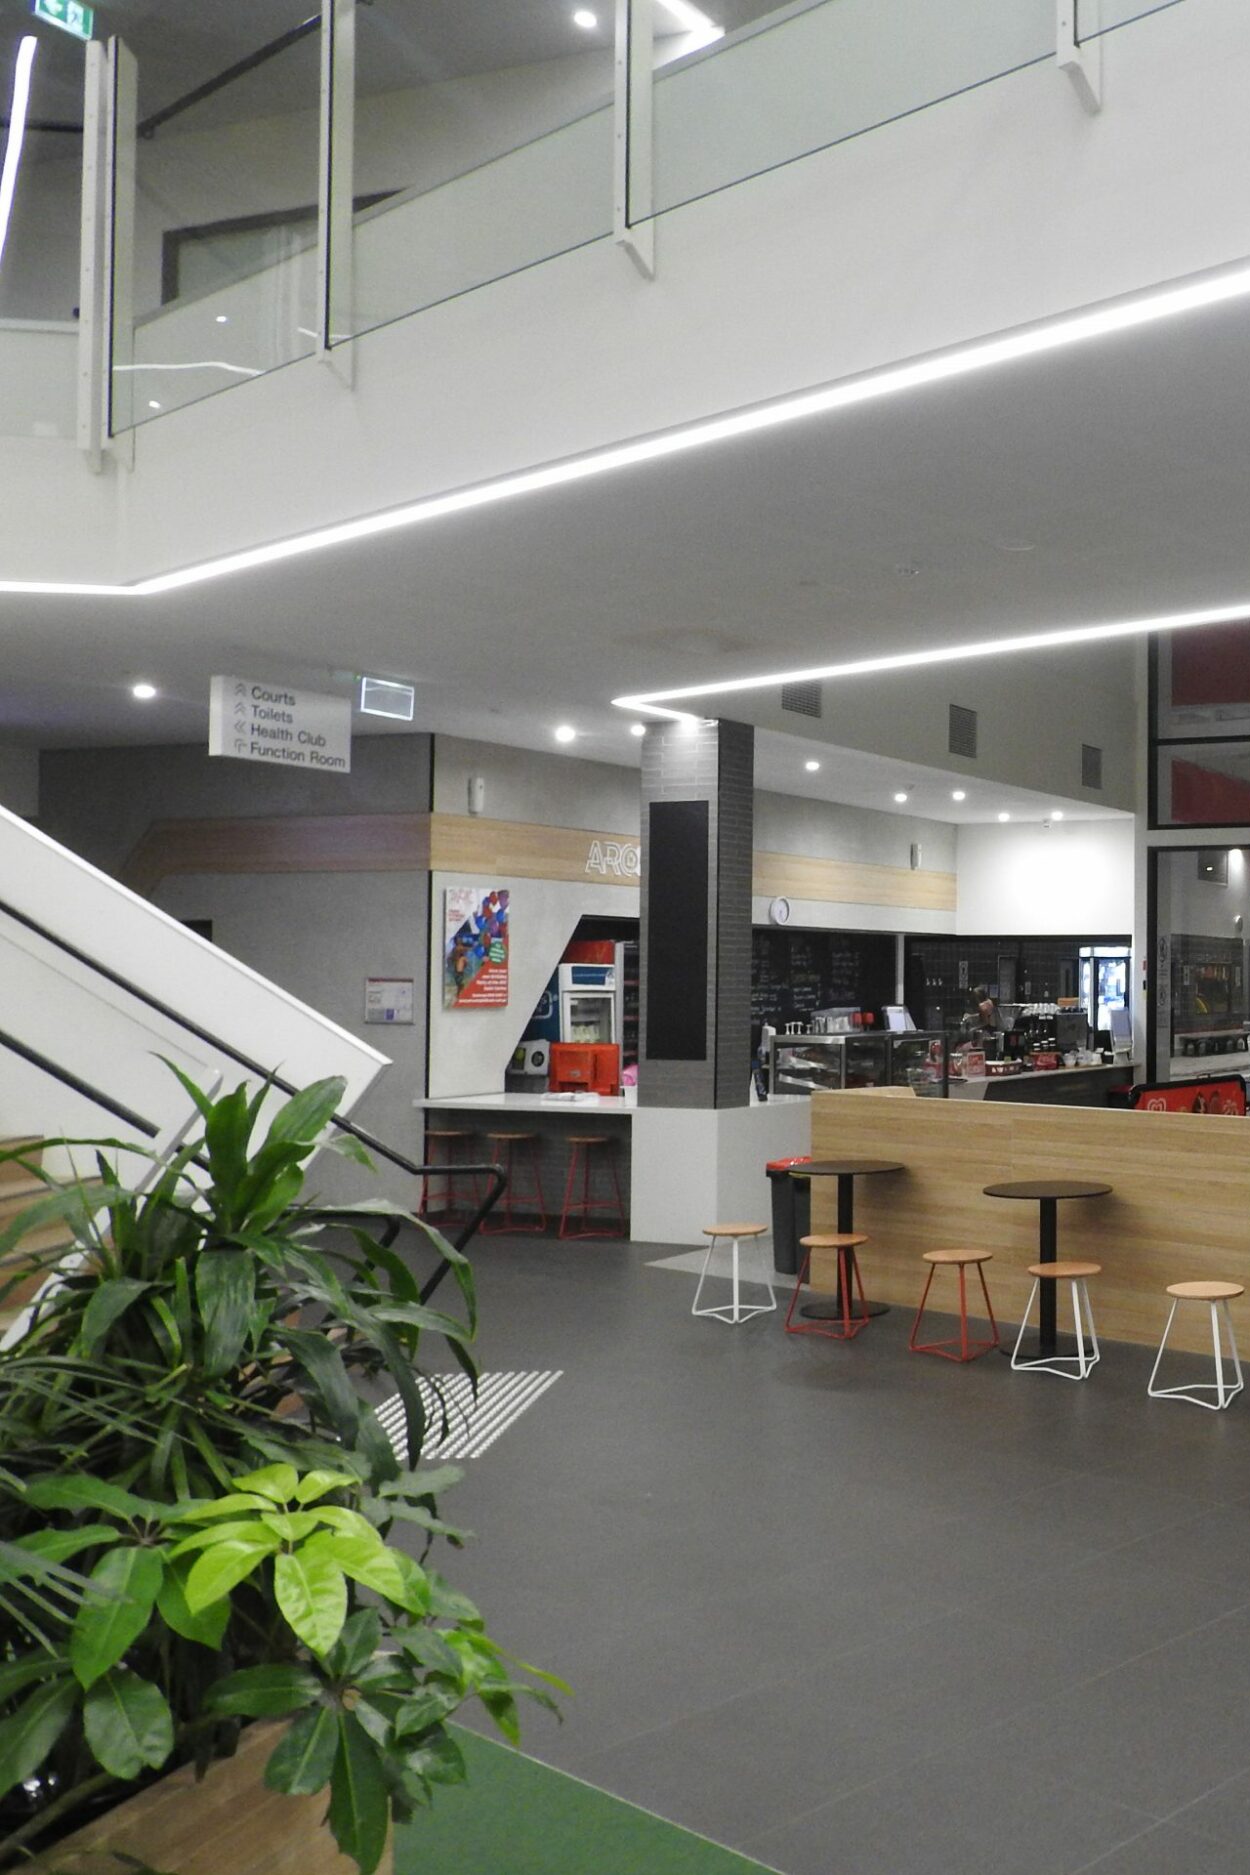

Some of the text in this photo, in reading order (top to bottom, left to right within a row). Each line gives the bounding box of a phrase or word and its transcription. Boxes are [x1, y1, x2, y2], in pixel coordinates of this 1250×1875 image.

[251, 685, 296, 707] Courts
[251, 705, 294, 724] Toilets
[250, 723, 327, 748] Health Club
[250, 742, 346, 769] Function Room
